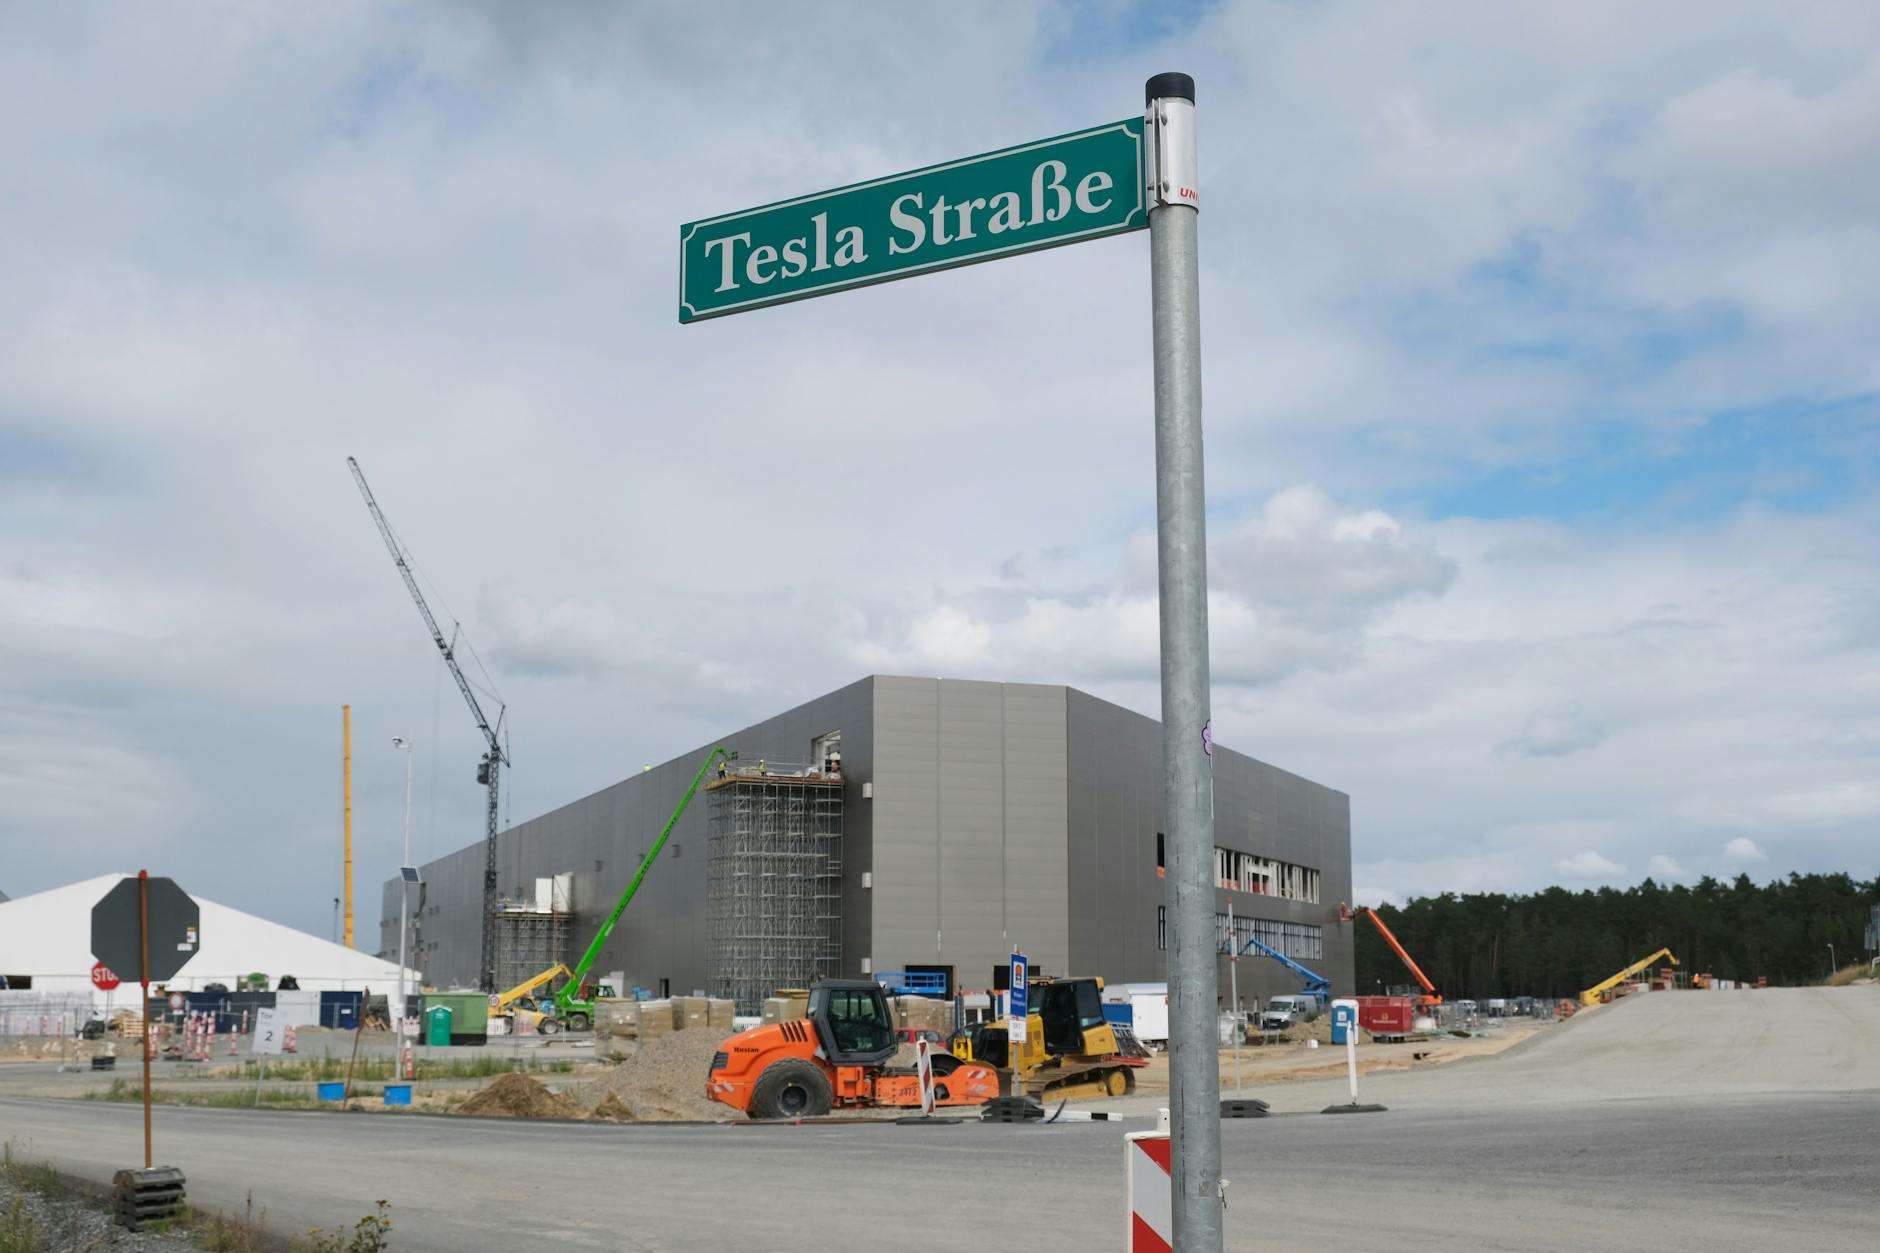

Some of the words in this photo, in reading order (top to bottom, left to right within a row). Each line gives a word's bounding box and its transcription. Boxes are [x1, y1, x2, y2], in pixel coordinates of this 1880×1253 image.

[704, 211, 869, 293] Tesla
[888, 159, 1114, 256] Straße
[93, 967, 118, 982] STO
[265, 1031, 273, 1041] 2
